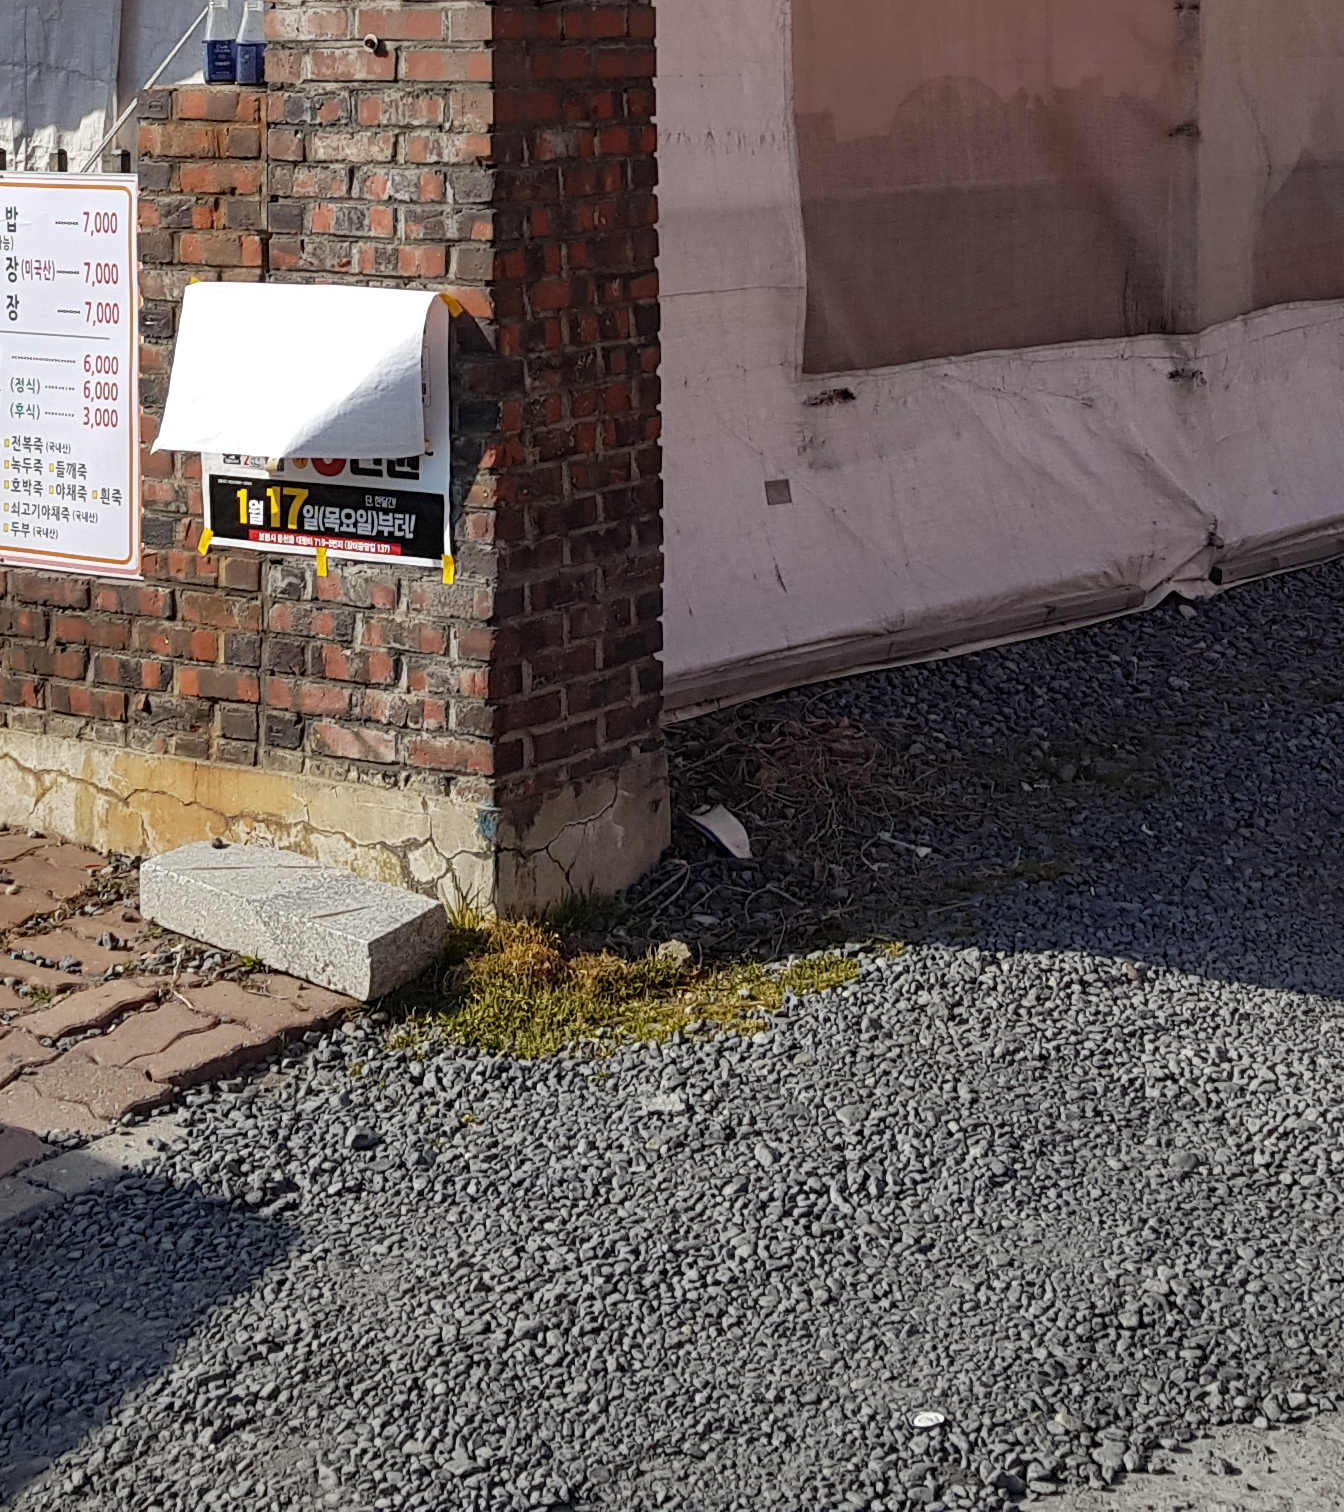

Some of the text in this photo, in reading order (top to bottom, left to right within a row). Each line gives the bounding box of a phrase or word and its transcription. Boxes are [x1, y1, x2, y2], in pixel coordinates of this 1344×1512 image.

[83, 211, 118, 236] 7,000
[21, 258, 55, 281] (미국산)
[84, 262, 119, 287] 7,000
[85, 301, 120, 326] 7,000
[83, 354, 119, 376] 6,000
[10, 376, 40, 395] (정식)
[83, 380, 118, 402] 6,000
[10, 402, 40, 420] (후식)
[83, 406, 118, 429] 3,000
[11, 434, 44, 454] 전복죽
[11, 456, 88, 481] 녹두죽 들깨죽
[11, 478, 43, 498] 호박죽
[56, 482, 88, 503] 야채죽
[236, 488, 264, 526] 1월
[11, 521, 31, 538] 두부
